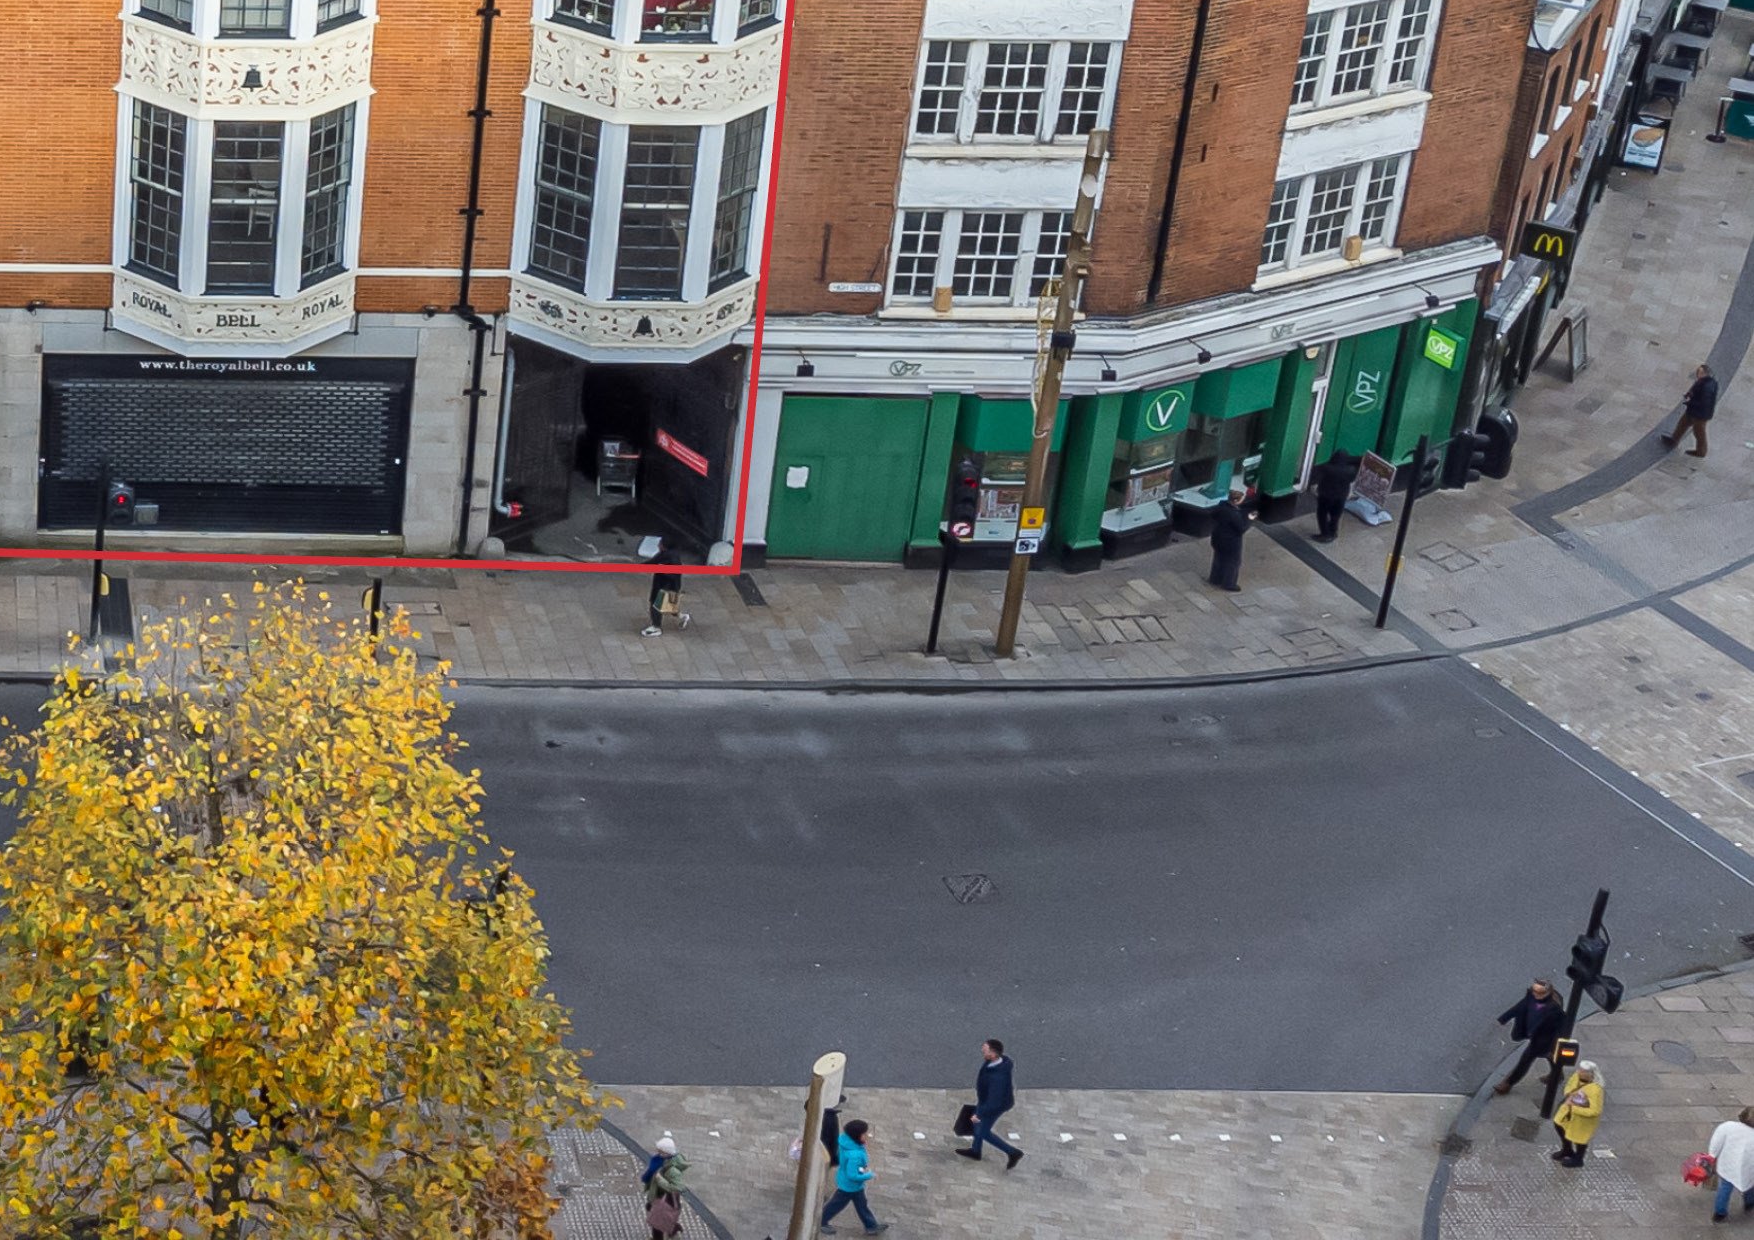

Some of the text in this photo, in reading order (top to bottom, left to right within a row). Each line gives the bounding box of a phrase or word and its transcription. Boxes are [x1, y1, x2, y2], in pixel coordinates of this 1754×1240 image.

[132, 291, 344, 328] ROYAL BELL ROYAL
[1428, 336, 1455, 361] VPZ
[139, 360, 317, 373] www.theroyalbell.co.uk
[1349, 370, 1381, 410] VPZ
